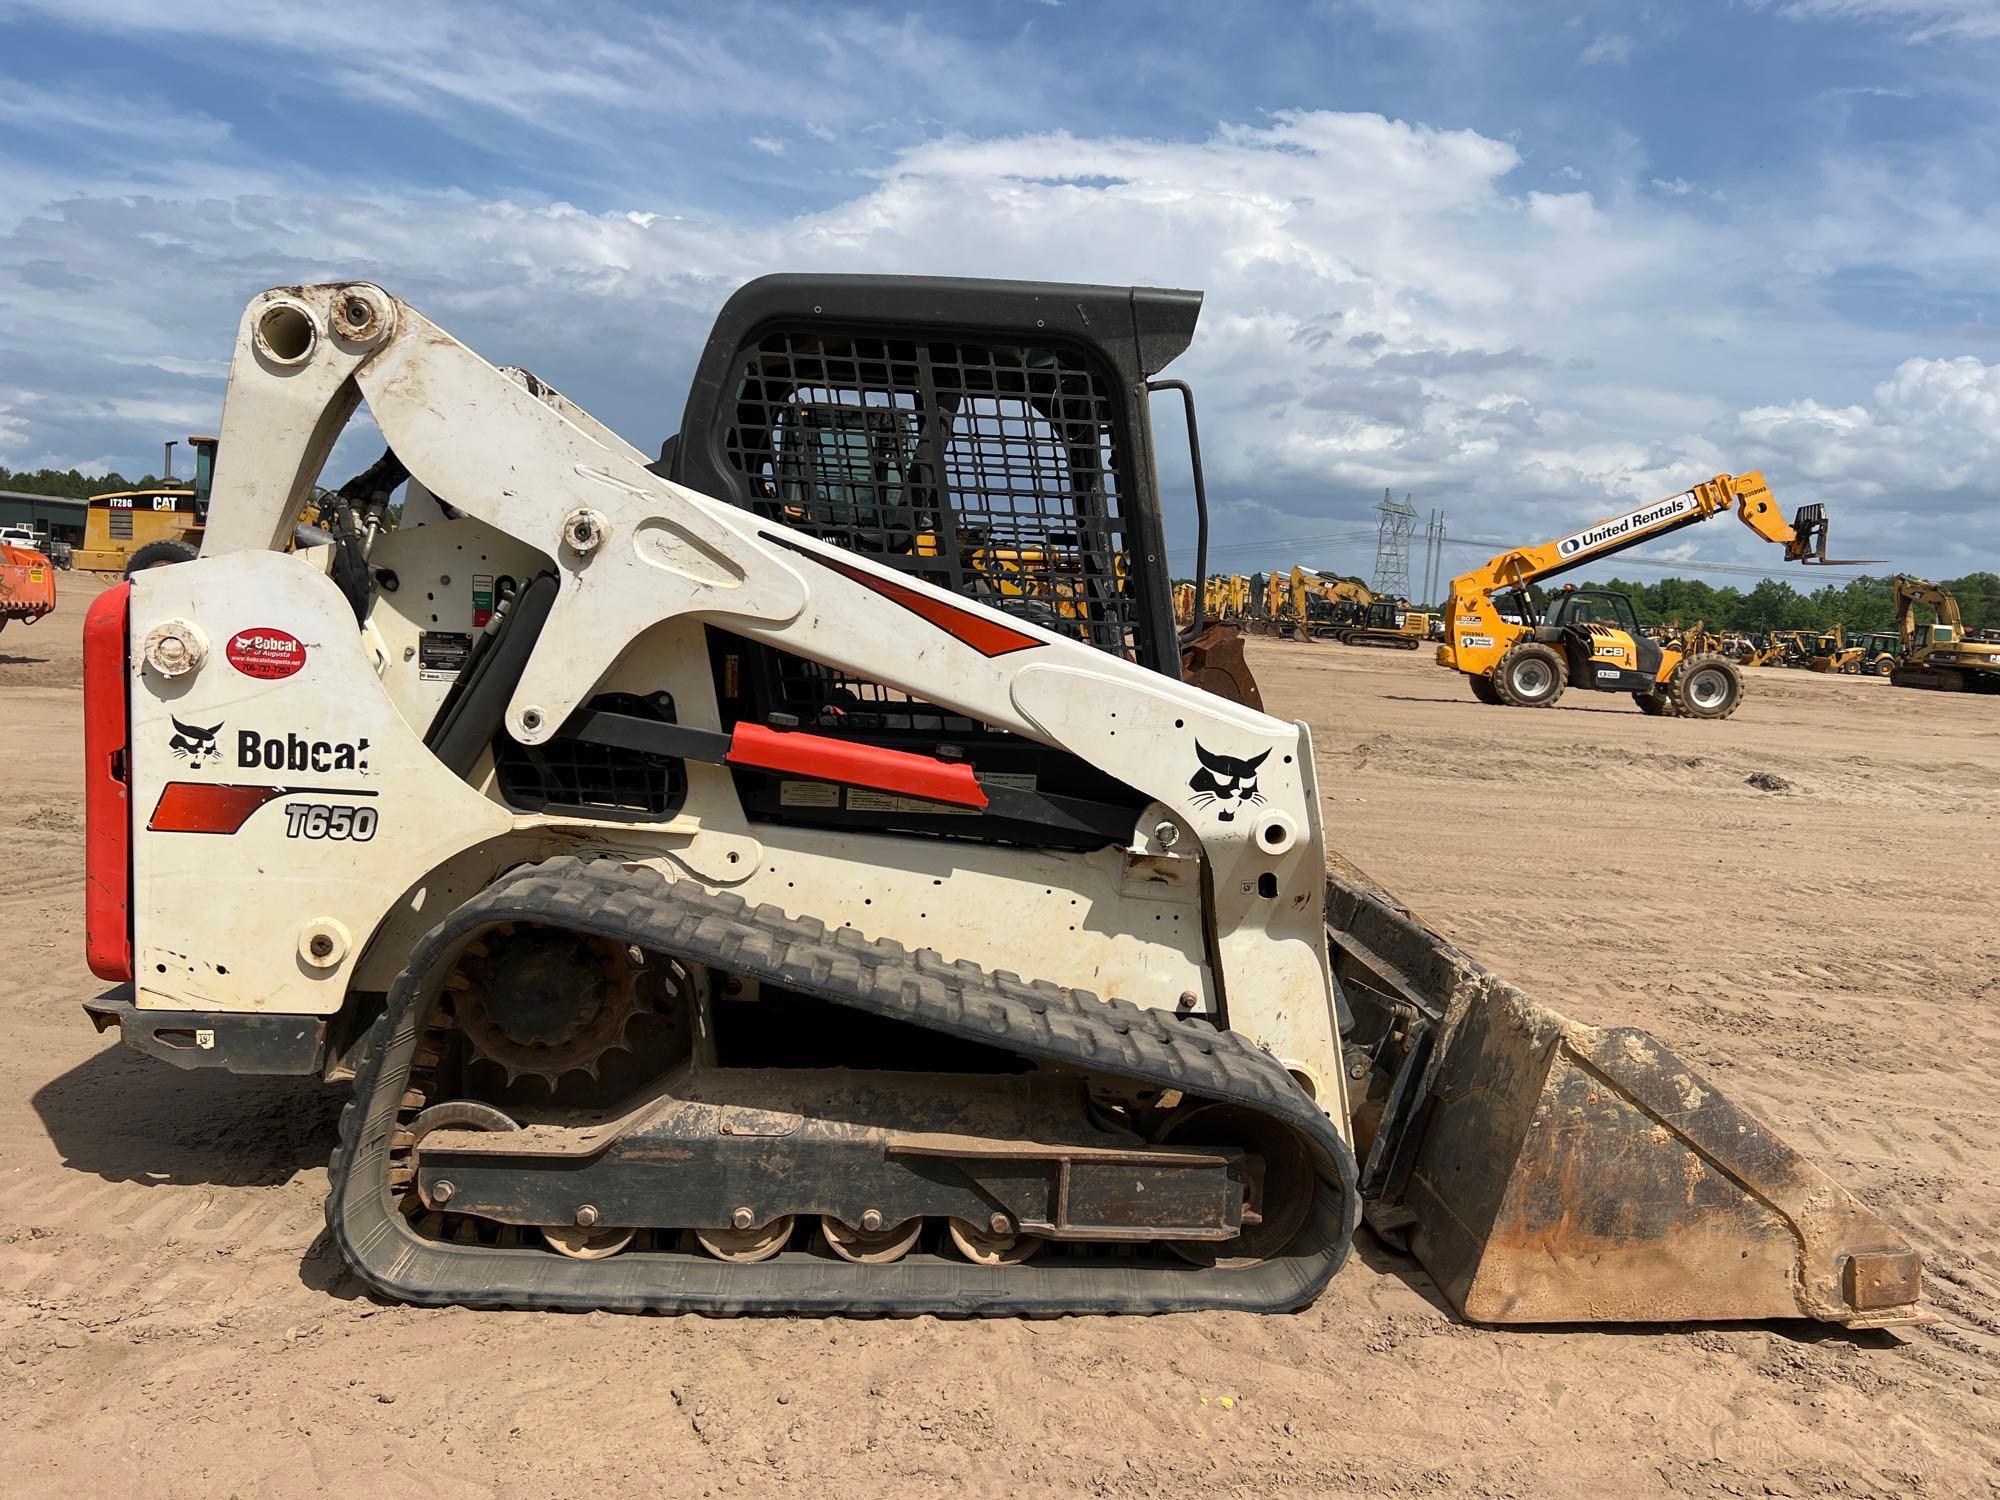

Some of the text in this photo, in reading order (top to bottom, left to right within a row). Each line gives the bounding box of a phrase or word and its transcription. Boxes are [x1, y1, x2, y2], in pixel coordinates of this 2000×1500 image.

[109, 498, 133, 508] IT28G
[152, 496, 178, 511] CAT
[1582, 500, 1685, 546] United Rentals
[254, 636, 297, 652] Bobcat
[1594, 647, 1624, 656] JCB
[262, 650, 291, 658] Augusta
[285, 803, 379, 842] T650
